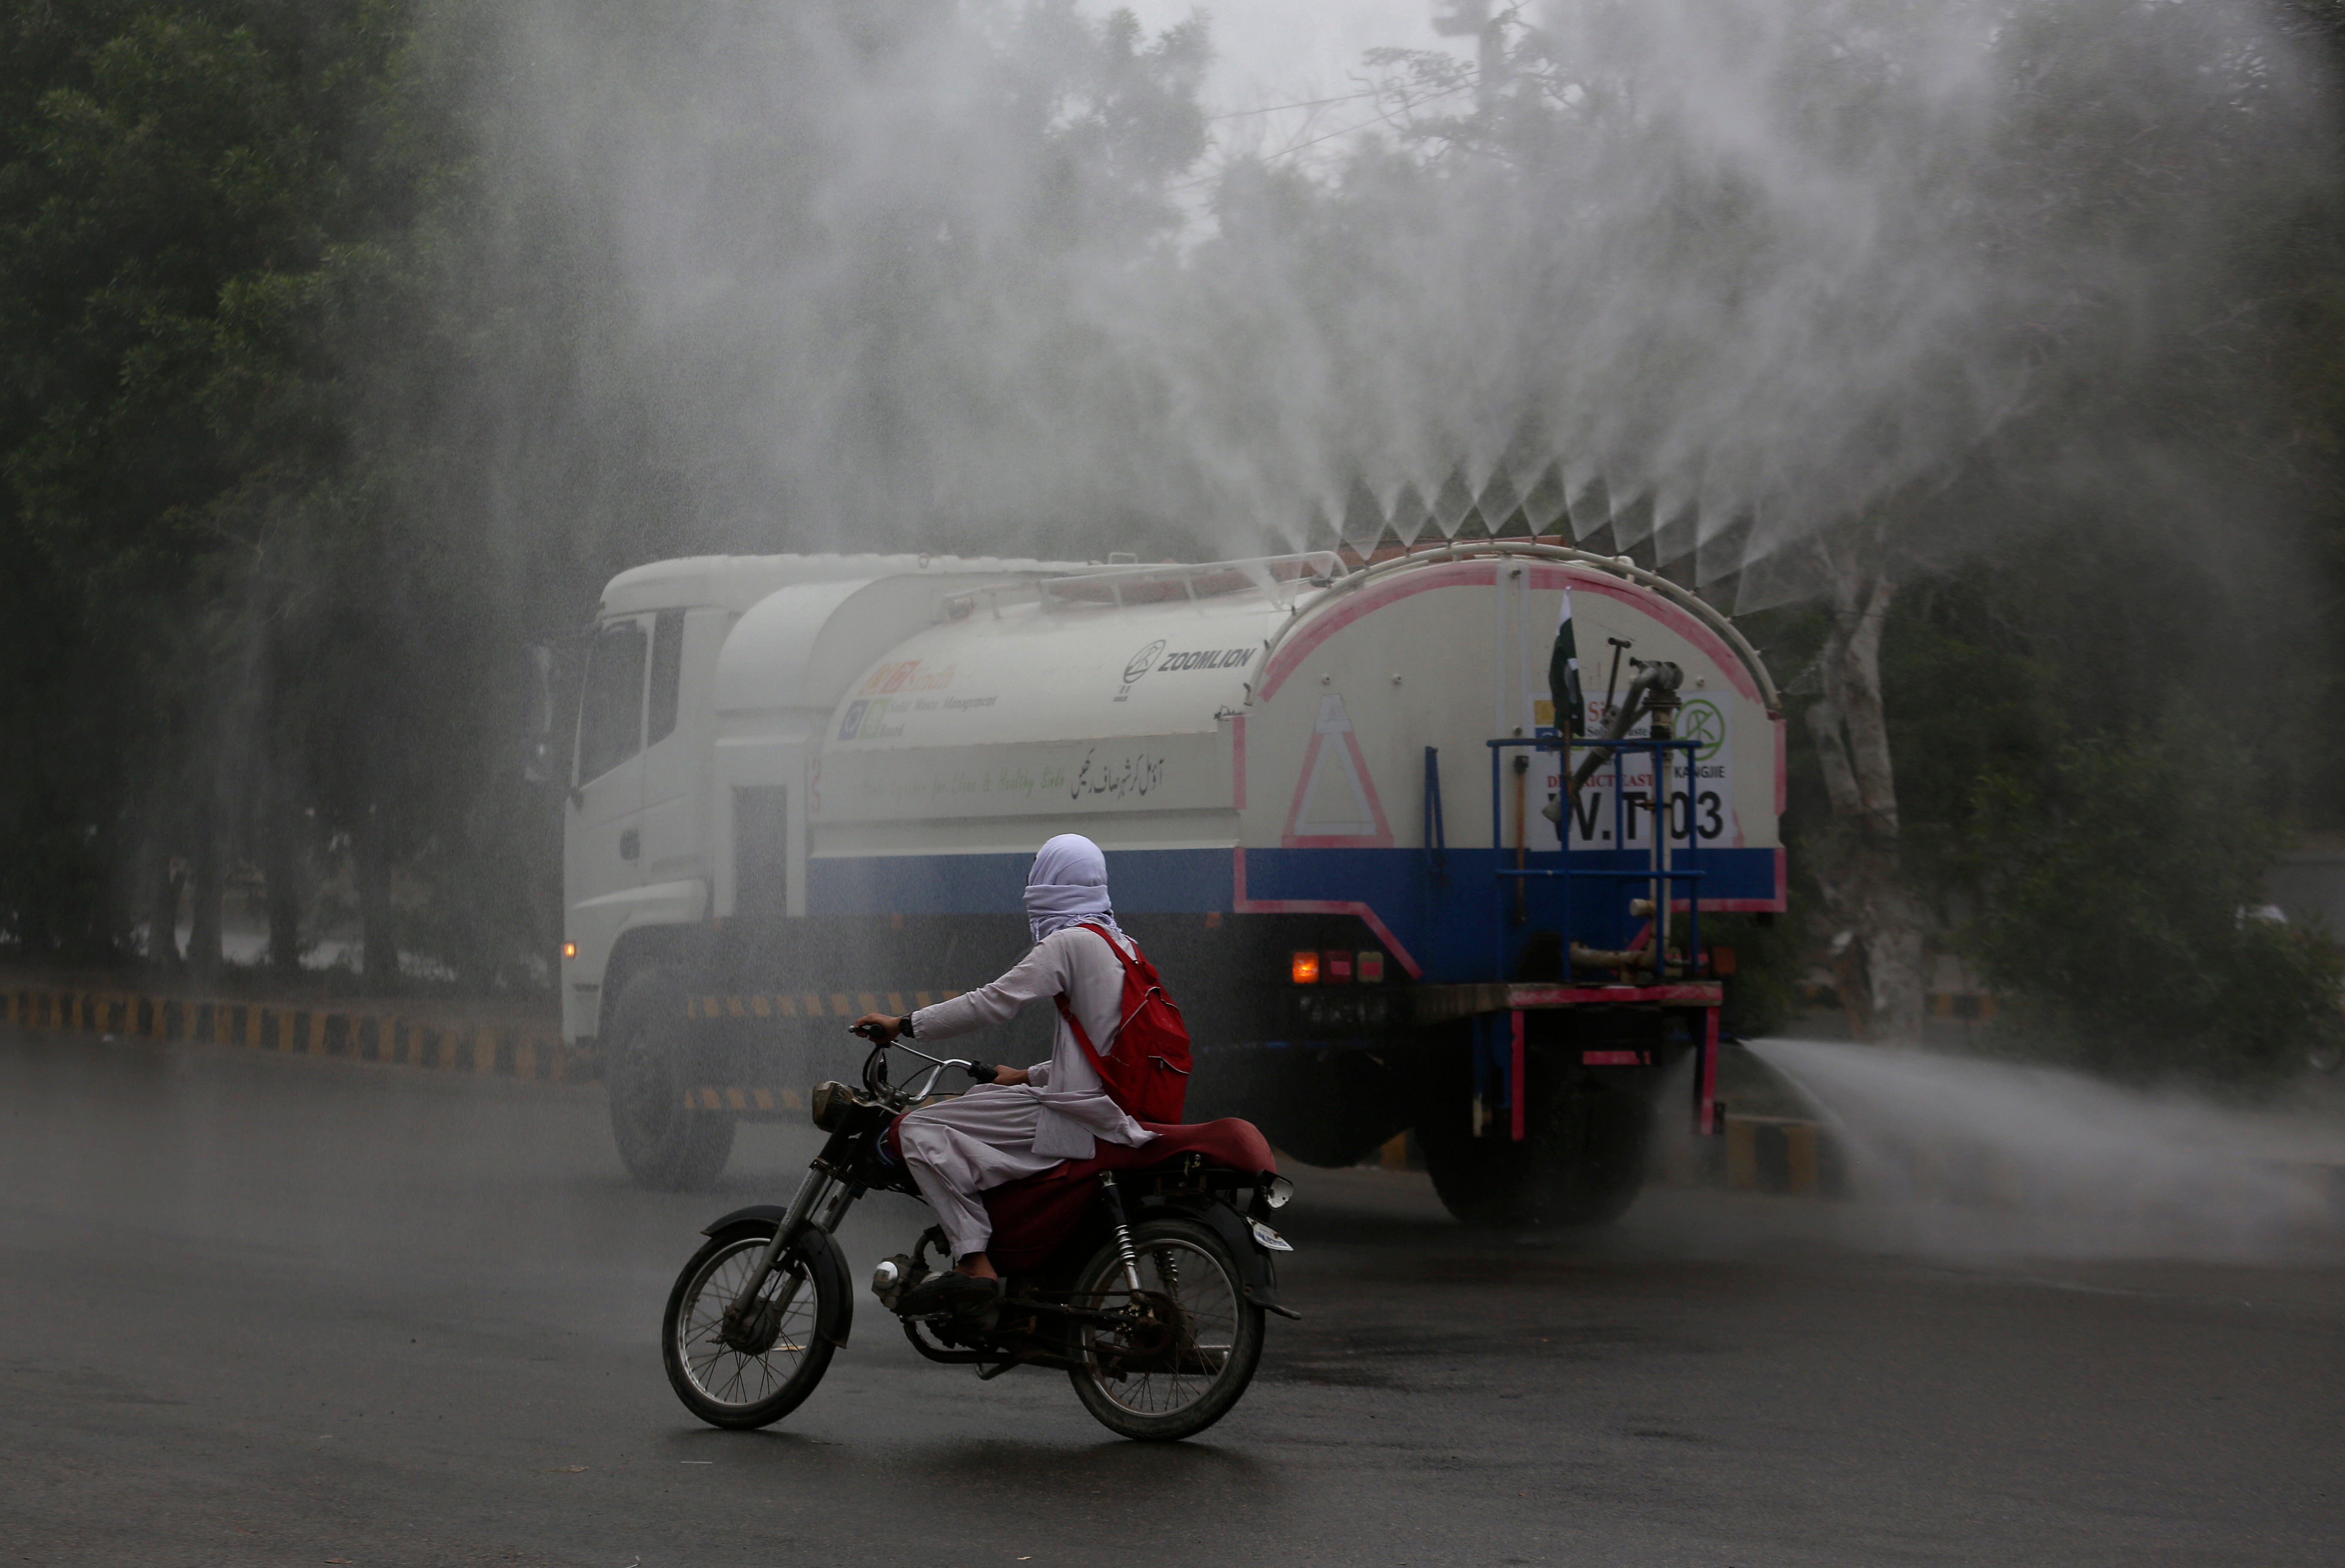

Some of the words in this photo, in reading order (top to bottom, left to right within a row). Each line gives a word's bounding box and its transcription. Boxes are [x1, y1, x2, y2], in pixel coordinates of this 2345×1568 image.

[1158, 648, 1257, 672] ZOOMLION
[914, 697, 939, 711] Waste
[942, 694, 998, 712] Management
